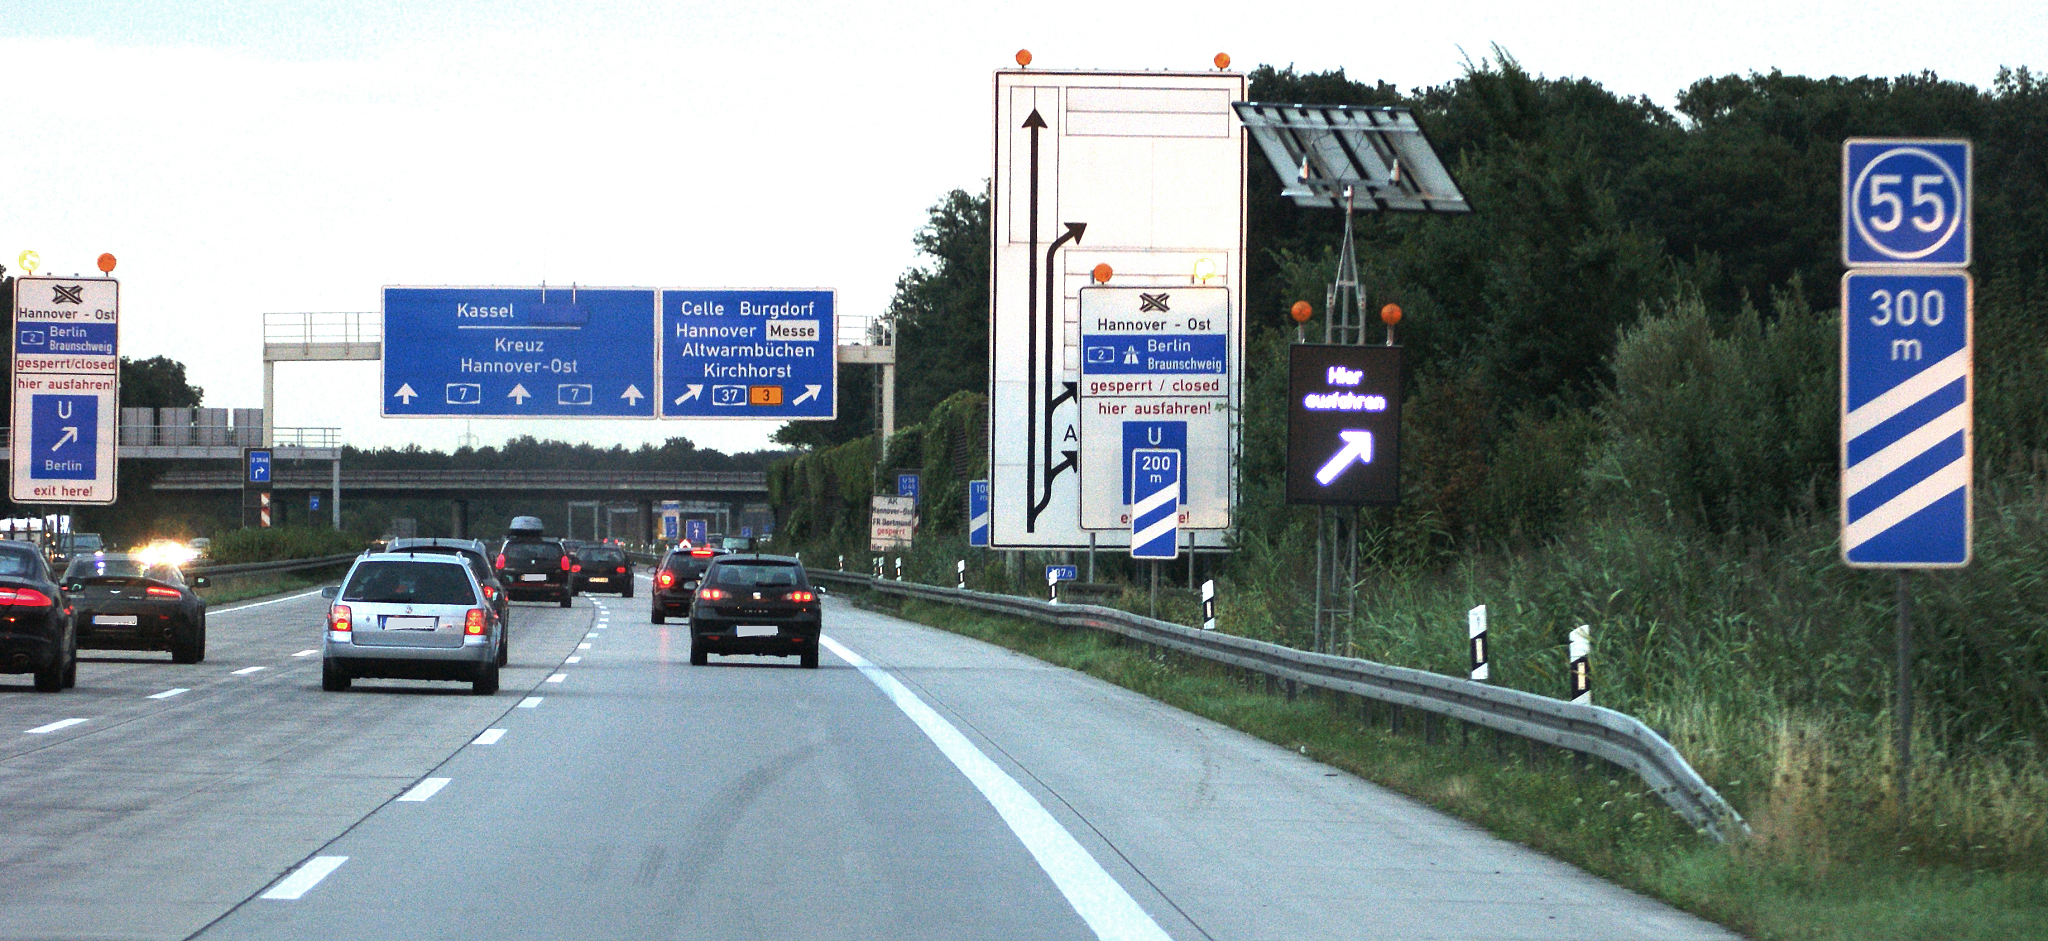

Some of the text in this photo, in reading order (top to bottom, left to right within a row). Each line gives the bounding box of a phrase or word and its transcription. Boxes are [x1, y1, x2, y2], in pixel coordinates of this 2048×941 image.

[1869, 174, 1946, 232] 55
[19, 308, 78, 319] Hannover
[95, 309, 115, 320] Ost
[457, 303, 514, 317] Kassel
[681, 301, 815, 319] Celle Burgdorf
[1869, 289, 1945, 327] 300
[676, 323, 815, 337] Hannover Messe
[1098, 318, 1167, 331] Hannover
[1188, 318, 1211, 331] Ost
[29, 334, 36, 343] 2
[50, 326, 87, 338] Berlin
[50, 340, 113, 354] Braunschweig
[495, 338, 544, 352] Kreuz
[682, 343, 815, 357] Altwarmbüchen
[1148, 339, 1191, 352] Berlin
[1891, 339, 1923, 361] m
[1098, 350, 1105, 360] 2
[17, 359, 115, 371] gesperrt/closed
[461, 358, 578, 373] Hannover-Ost
[704, 363, 792, 378] Kirchhorst
[1148, 356, 1222, 372] Braunschweig
[18, 378, 114, 391] hier ausfahren!
[1090, 380, 1153, 394] gesperrt
[1172, 379, 1219, 391] closed
[459, 388, 467, 399] 7
[571, 389, 579, 400] 7
[721, 389, 738, 402] 37
[763, 389, 770, 401] 3
[58, 400, 72, 419] U
[1099, 402, 1211, 415] hier ausfahren!
[1148, 427, 1162, 446] U
[45, 460, 82, 471] Berlin
[1142, 456, 1171, 471] 200
[1150, 473, 1162, 483] m
[34, 485, 93, 497] exit here!
